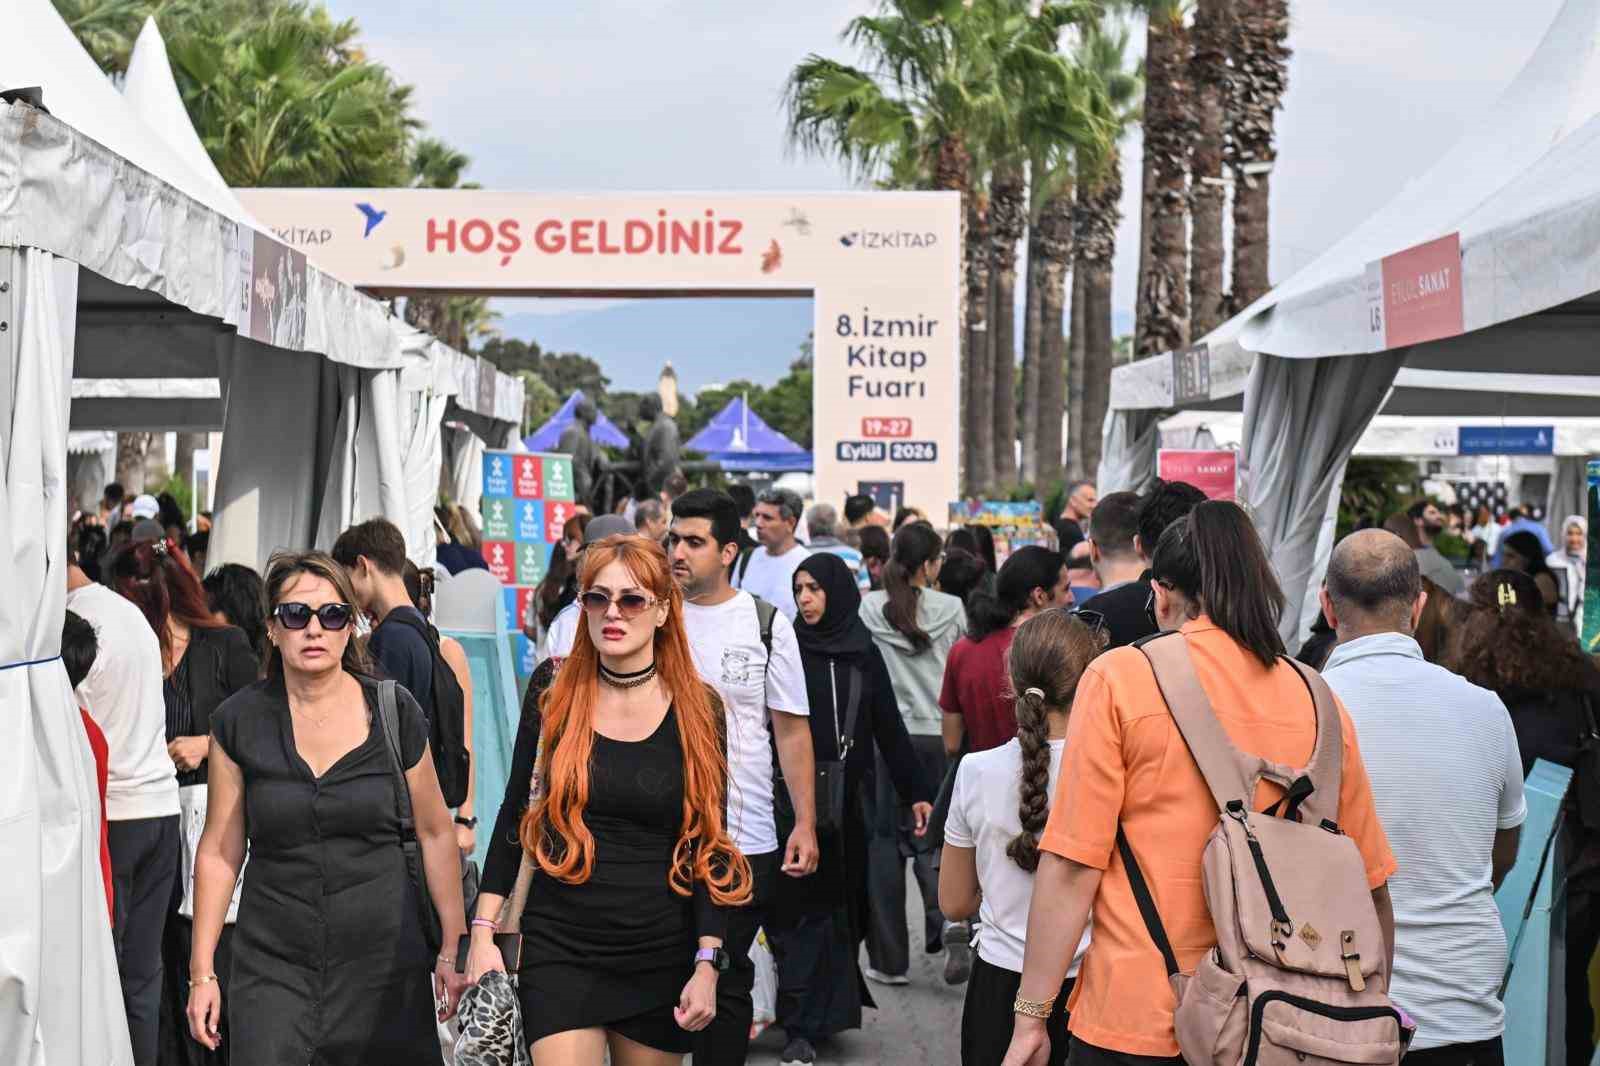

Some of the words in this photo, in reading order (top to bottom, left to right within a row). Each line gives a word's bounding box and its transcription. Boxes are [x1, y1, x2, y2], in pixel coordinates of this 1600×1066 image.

[426, 218, 522, 267] HOŞ
[534, 208, 743, 256] GELDİNİZ
[861, 228, 937, 250] İZKİTAP
[863, 306, 938, 337] İzmir
[848, 344, 927, 373] Kitap
[849, 375, 925, 398] Fuarı
[866, 420, 908, 434] 19-27
[841, 444, 882, 460] Eylül
